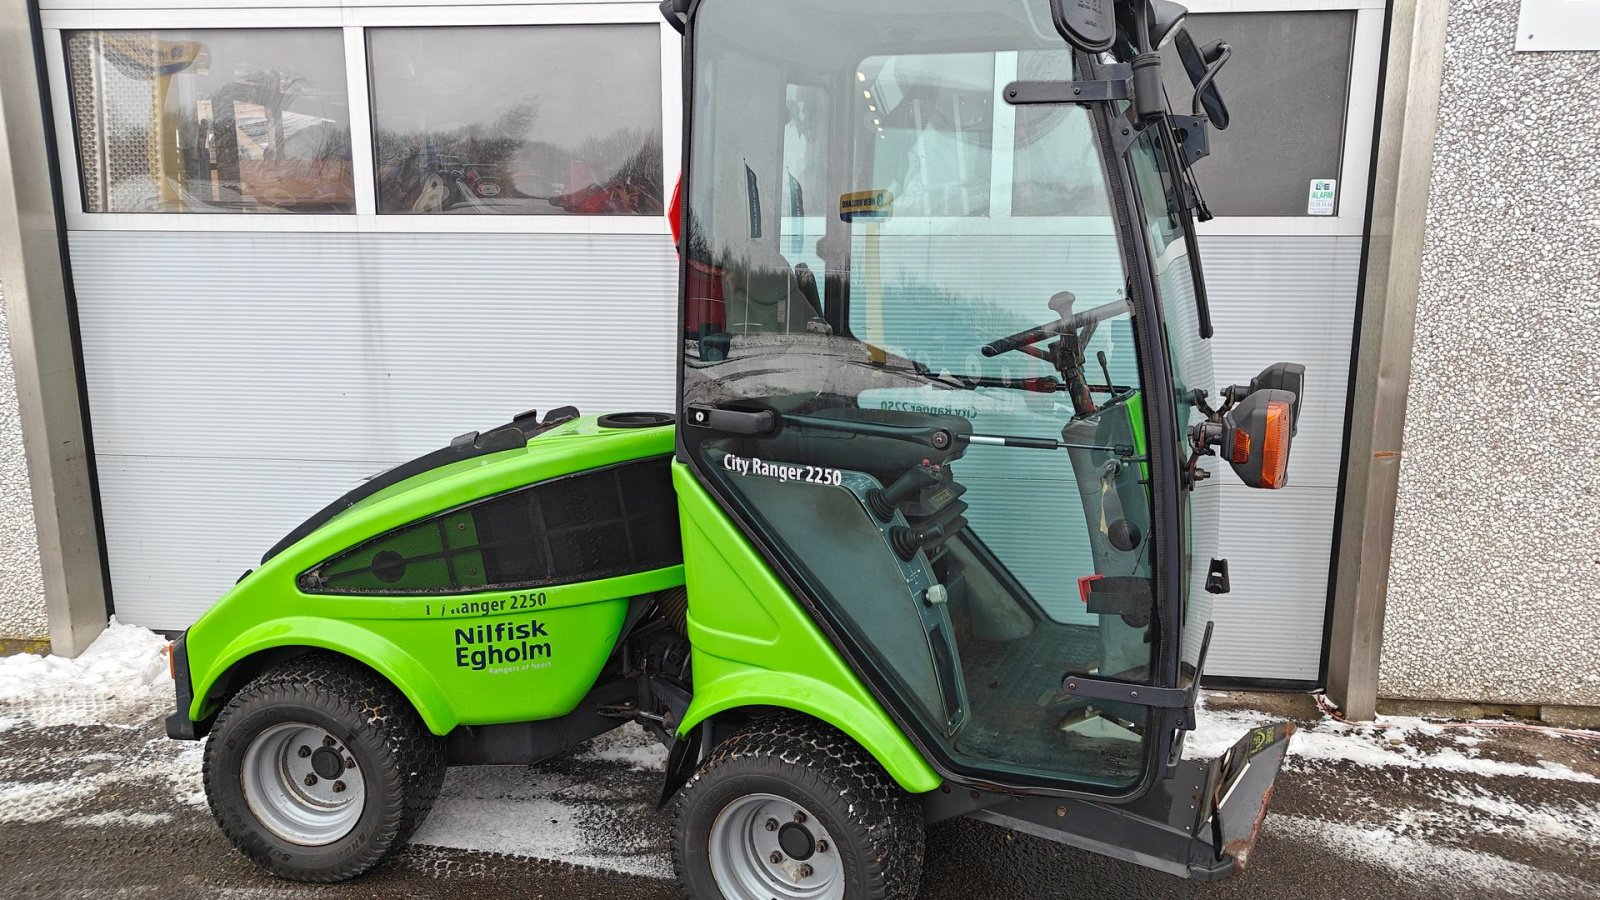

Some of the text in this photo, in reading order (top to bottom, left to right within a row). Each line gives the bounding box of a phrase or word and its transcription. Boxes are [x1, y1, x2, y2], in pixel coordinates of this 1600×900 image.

[1311, 191, 1333, 199] ALARM
[723, 453, 842, 486] City Ranger 2250
[510, 592, 547, 610] 2250
[455, 620, 548, 645] Nilfisk
[456, 641, 551, 670] Egholm
[489, 665, 520, 675] Rangers
